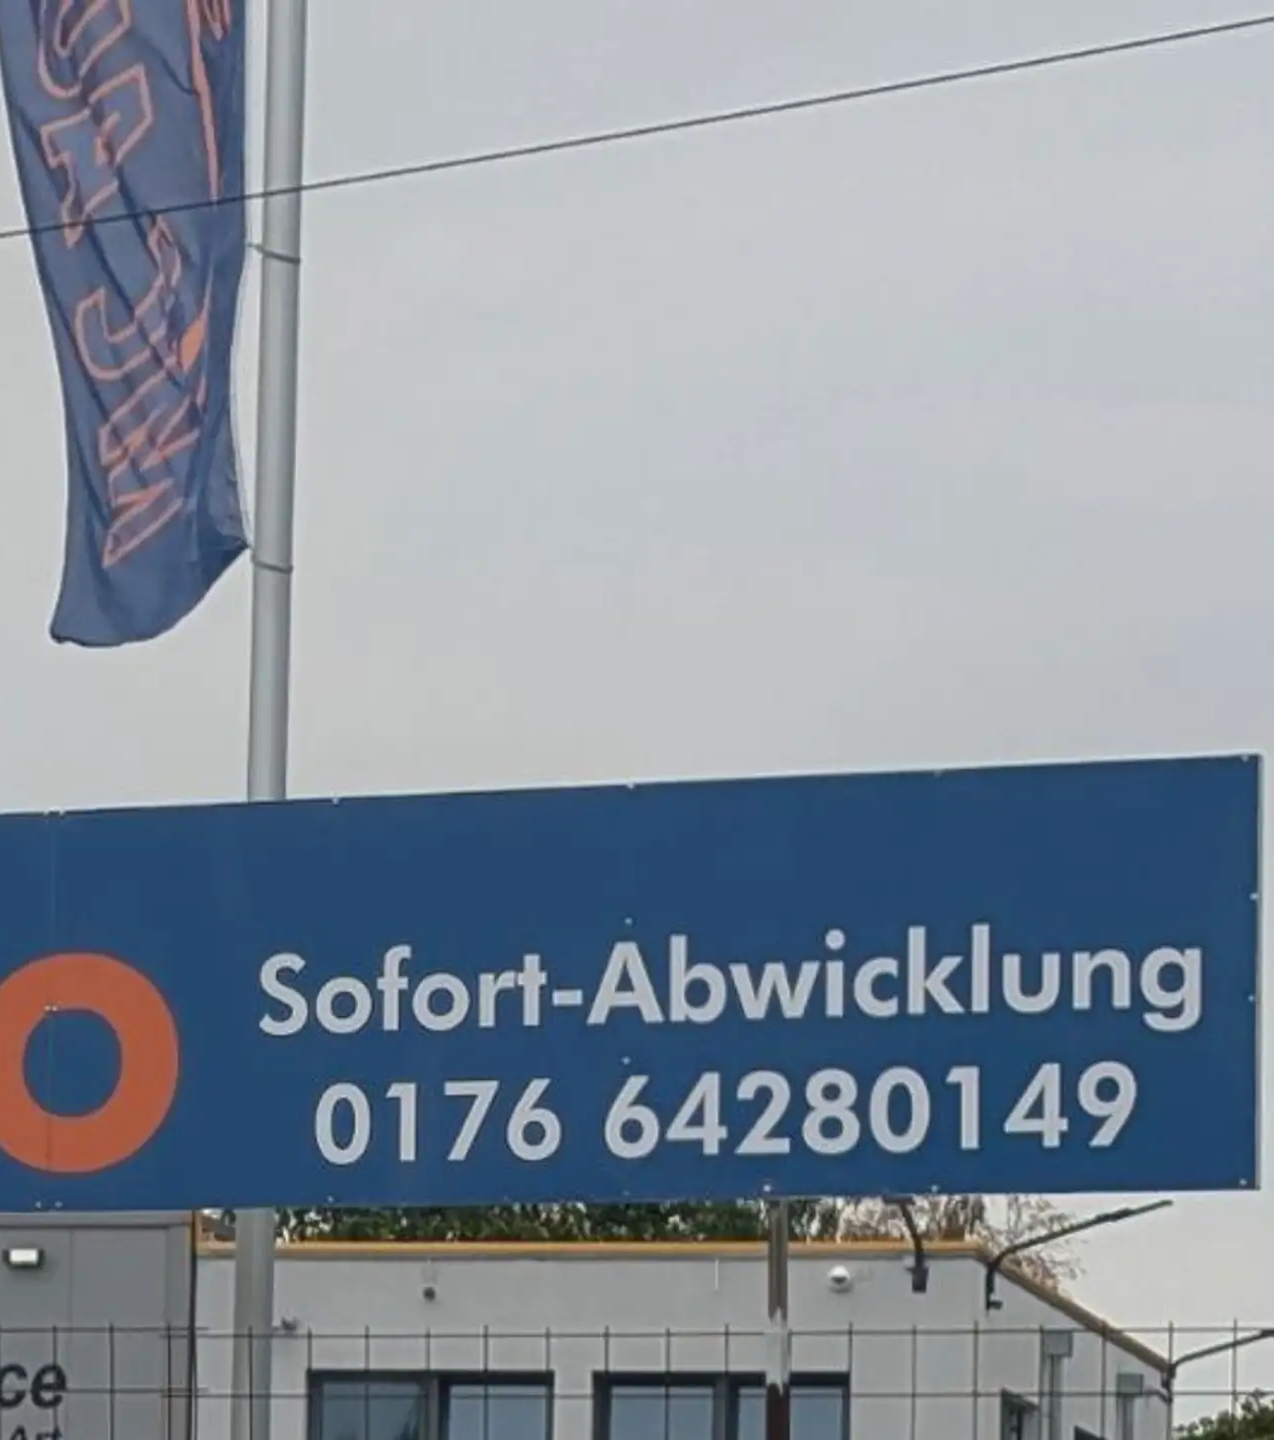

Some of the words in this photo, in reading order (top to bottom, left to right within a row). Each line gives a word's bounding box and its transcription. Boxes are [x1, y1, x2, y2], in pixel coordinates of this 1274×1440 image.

[257, 922, 1204, 1034] Sofort-Abwicklung
[313, 1079, 563, 1165] 0176
[603, 1060, 1139, 1160] 64280149
